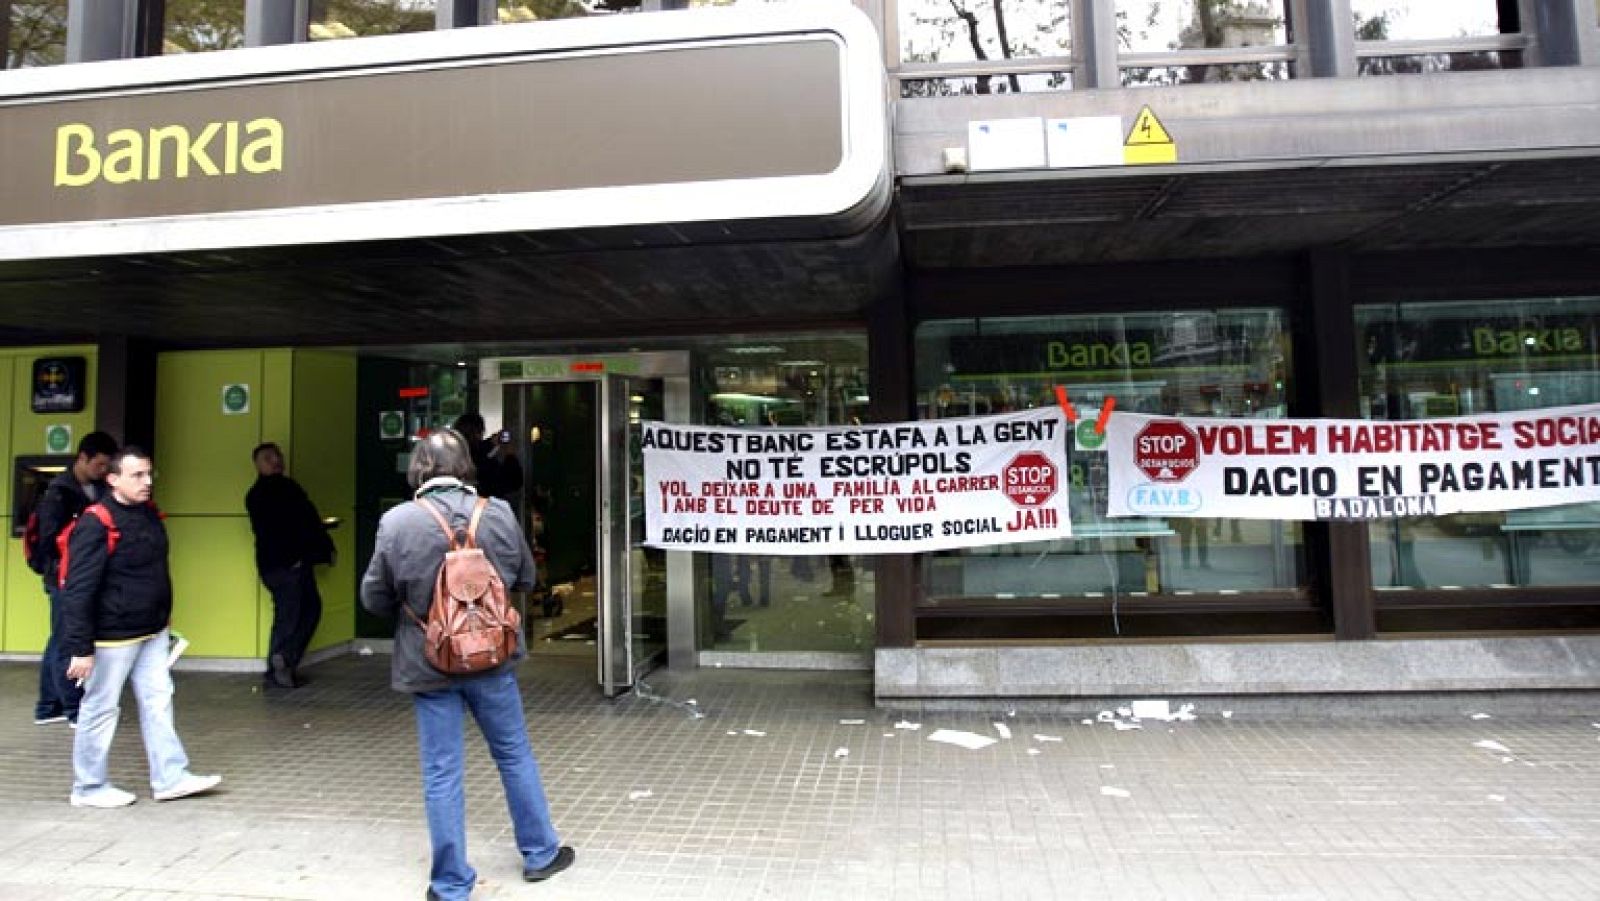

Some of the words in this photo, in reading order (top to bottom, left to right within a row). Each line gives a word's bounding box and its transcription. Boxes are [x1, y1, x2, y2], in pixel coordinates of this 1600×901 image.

[54, 117, 283, 187] Bankia
[826, 427, 926, 451] ESTAFA
[935, 426, 948, 447] A
[957, 425, 987, 445] LA
[994, 418, 1058, 442] GENT
[1140, 435, 1186, 453] STOP
[1196, 424, 1316, 455] VOLEM
[1327, 422, 1502, 454] HABITATGE
[727, 458, 760, 480] NO
[1008, 466, 1051, 484] STOP
[1224, 466, 1337, 497] DACIO
[1358, 464, 1403, 496] EN
[1419, 455, 1600, 492] PAGAMENT
[764, 482, 775, 497] A
[783, 482, 817, 498] UNA
[911, 478, 933, 495] AL
[936, 475, 1000, 493] CARRER
[674, 498, 707, 514] AMB
[714, 498, 737, 514] EL
[745, 499, 803, 515] DEUTE
[811, 499, 834, 514] DE
[849, 497, 884, 514] PER
[896, 496, 937, 513] VIDA
[1316, 495, 1435, 518] BADALONA
[715, 528, 737, 543] EN
[745, 527, 833, 543] PAGAMENT
[854, 523, 933, 541] LLOGUER
[942, 518, 1002, 536] SOCIAL
[1007, 508, 1058, 532] JA!!!
